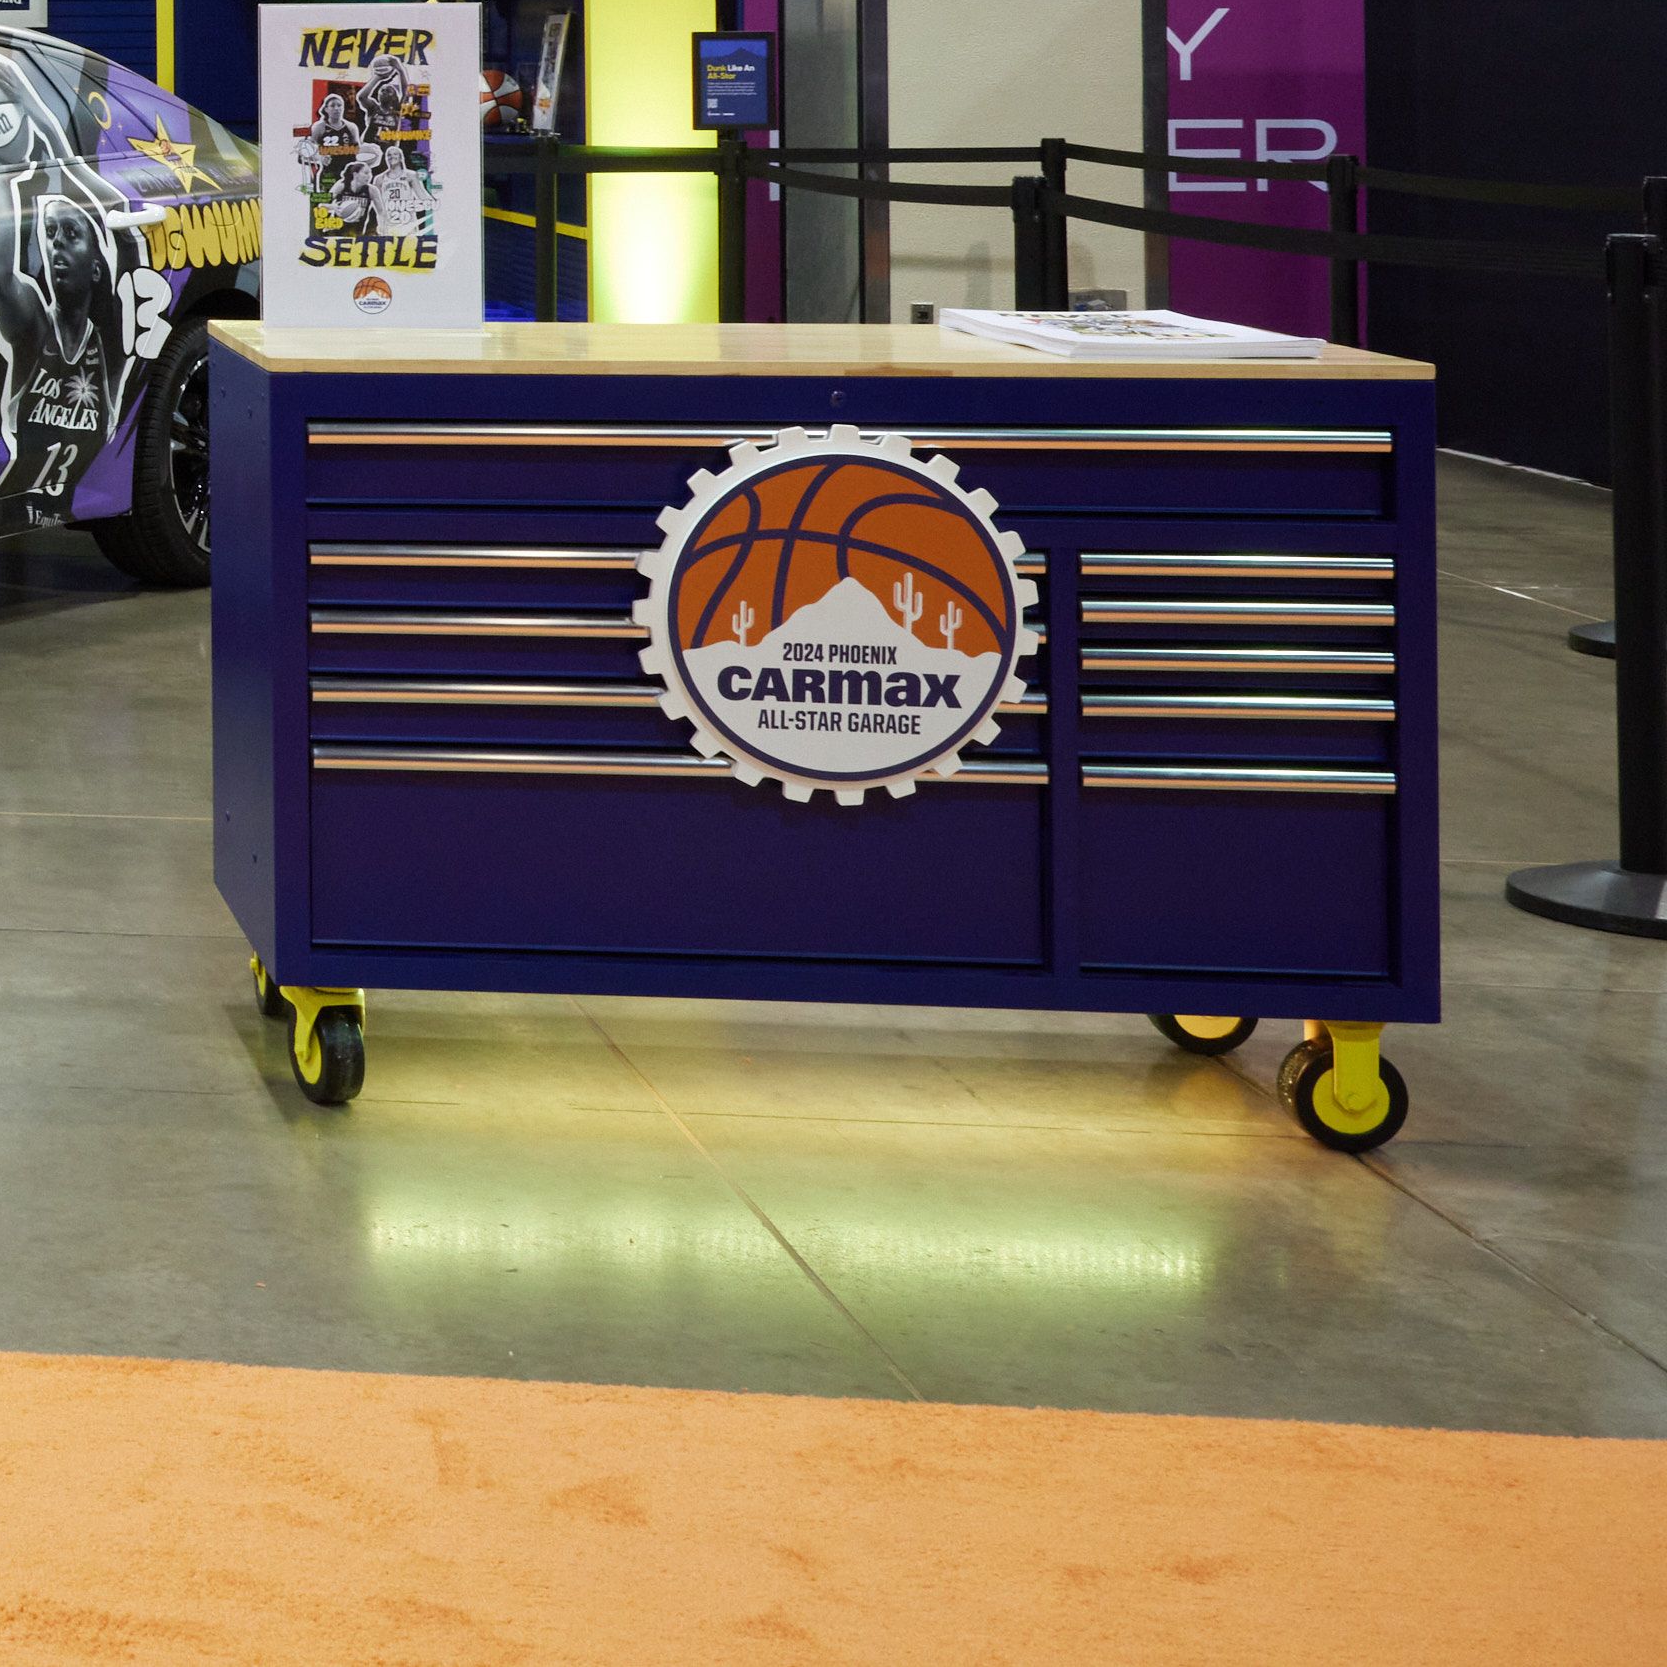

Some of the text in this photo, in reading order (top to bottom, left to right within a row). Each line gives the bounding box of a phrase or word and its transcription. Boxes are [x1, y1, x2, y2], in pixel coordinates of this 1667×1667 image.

[298, 27, 435, 70] NEVER
[707, 64, 755, 72] Dunk Like An
[323, 135, 340, 147] 22
[389, 188, 401, 200] 20
[299, 235, 438, 269] SETTLE
[116, 267, 173, 360] 13
[27, 442, 78, 496] 13
[783, 642, 897, 665] 2024 PHOENIX
[717, 666, 962, 709] CARmax
[758, 709, 922, 735] ALL-STAR GARAGE
